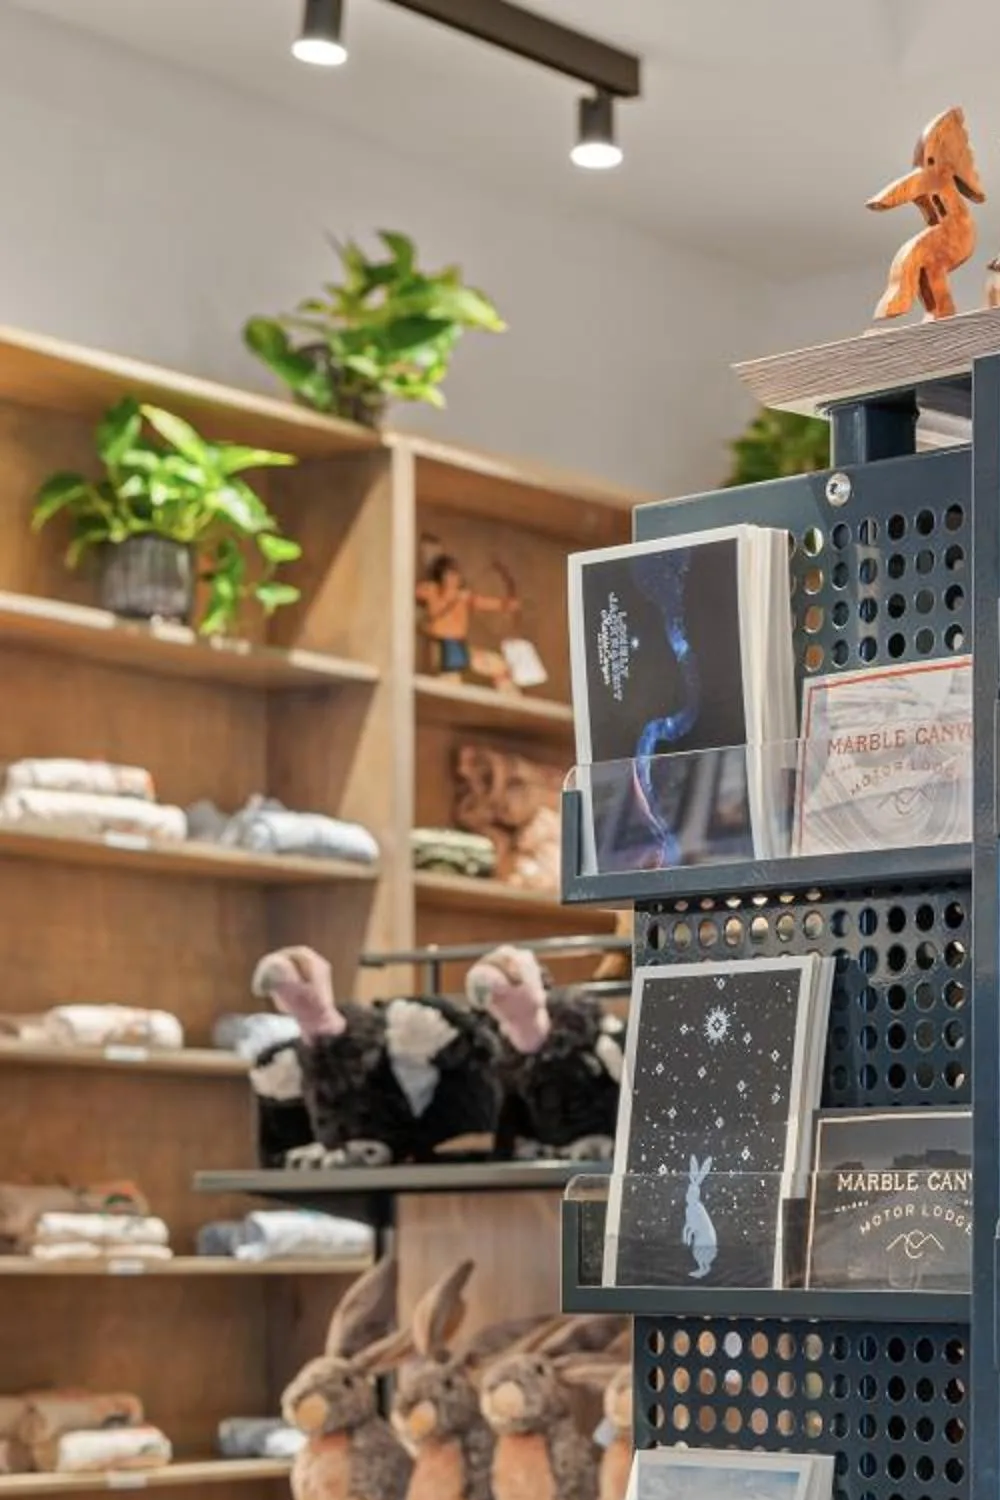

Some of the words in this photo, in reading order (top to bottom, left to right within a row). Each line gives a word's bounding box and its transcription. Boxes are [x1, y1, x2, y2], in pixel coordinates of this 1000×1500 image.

[827, 729, 906, 757] MARBLE
[837, 1172, 919, 1192] MARBLE
[860, 1203, 915, 1235] MOTOR
